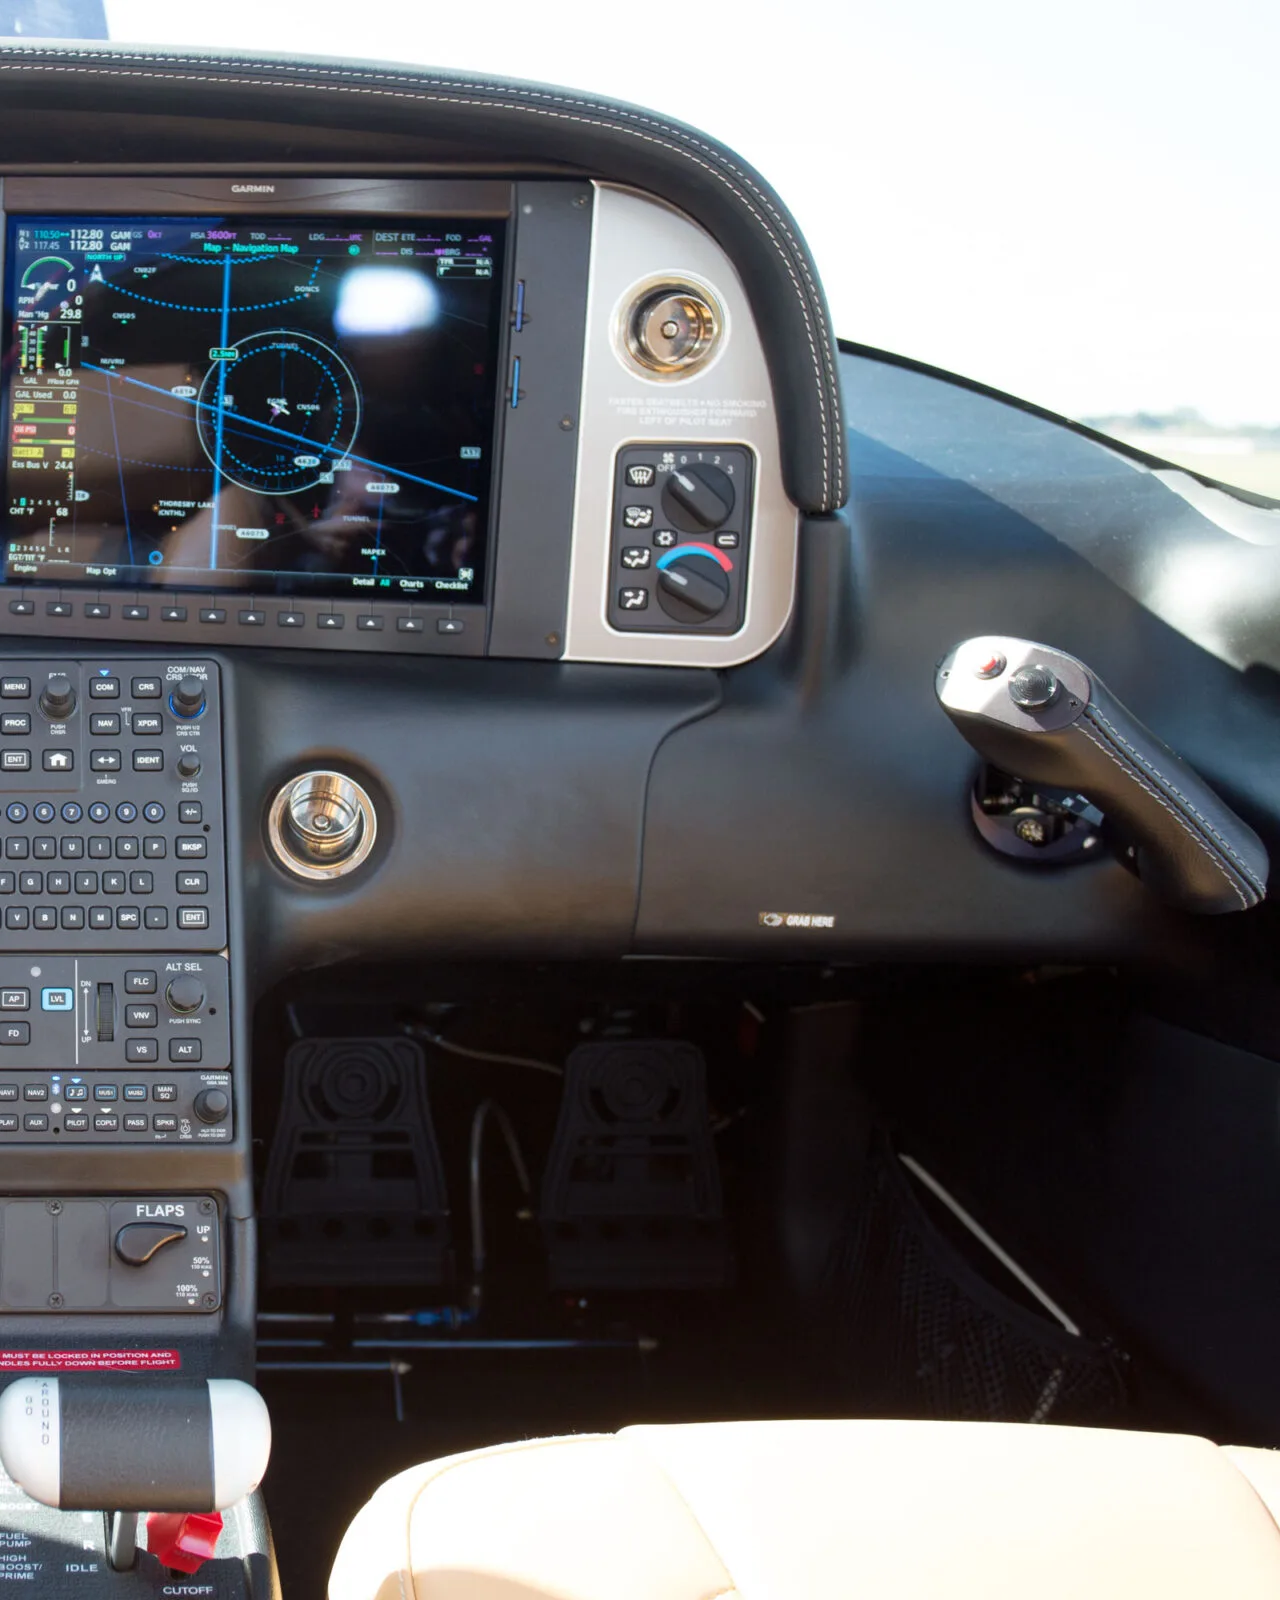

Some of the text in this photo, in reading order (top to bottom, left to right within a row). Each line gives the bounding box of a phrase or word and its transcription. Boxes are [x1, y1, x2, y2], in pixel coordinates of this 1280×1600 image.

[231, 185, 275, 193] GARMIN
[34, 230, 131, 240] 110.50 112.80 GAM
[34, 241, 130, 251] 117.45 112.80 GAM
[204, 243, 298, 254] Map Navigation Map
[681, 456, 687, 464] 0
[714, 456, 720, 464] 2
[657, 464, 676, 472] OFF
[727, 466, 733, 474] 3
[361, 548, 386, 556] NAPEX
[13, 564, 37, 573] Engine
[86, 567, 117, 576] Map Opt
[400, 579, 424, 589] Charts
[435, 581, 468, 590] Checklist
[4, 719, 27, 727] PROC
[787, 915, 834, 927] GRAB HERE
[166, 963, 202, 971] ALT SEL
[50, 995, 64, 1003] LVL
[136, 1046, 148, 1054] VS
[178, 1046, 193, 1054] ALT
[136, 1204, 185, 1217] FLAPS
[196, 1225, 211, 1234] UP
[193, 1257, 210, 1265] 50%
[176, 1284, 198, 1292] 100%
[41, 1382, 50, 1445] AROUND
[66, 1564, 99, 1572] IDLE
[163, 1586, 214, 1595] CUTOFF
